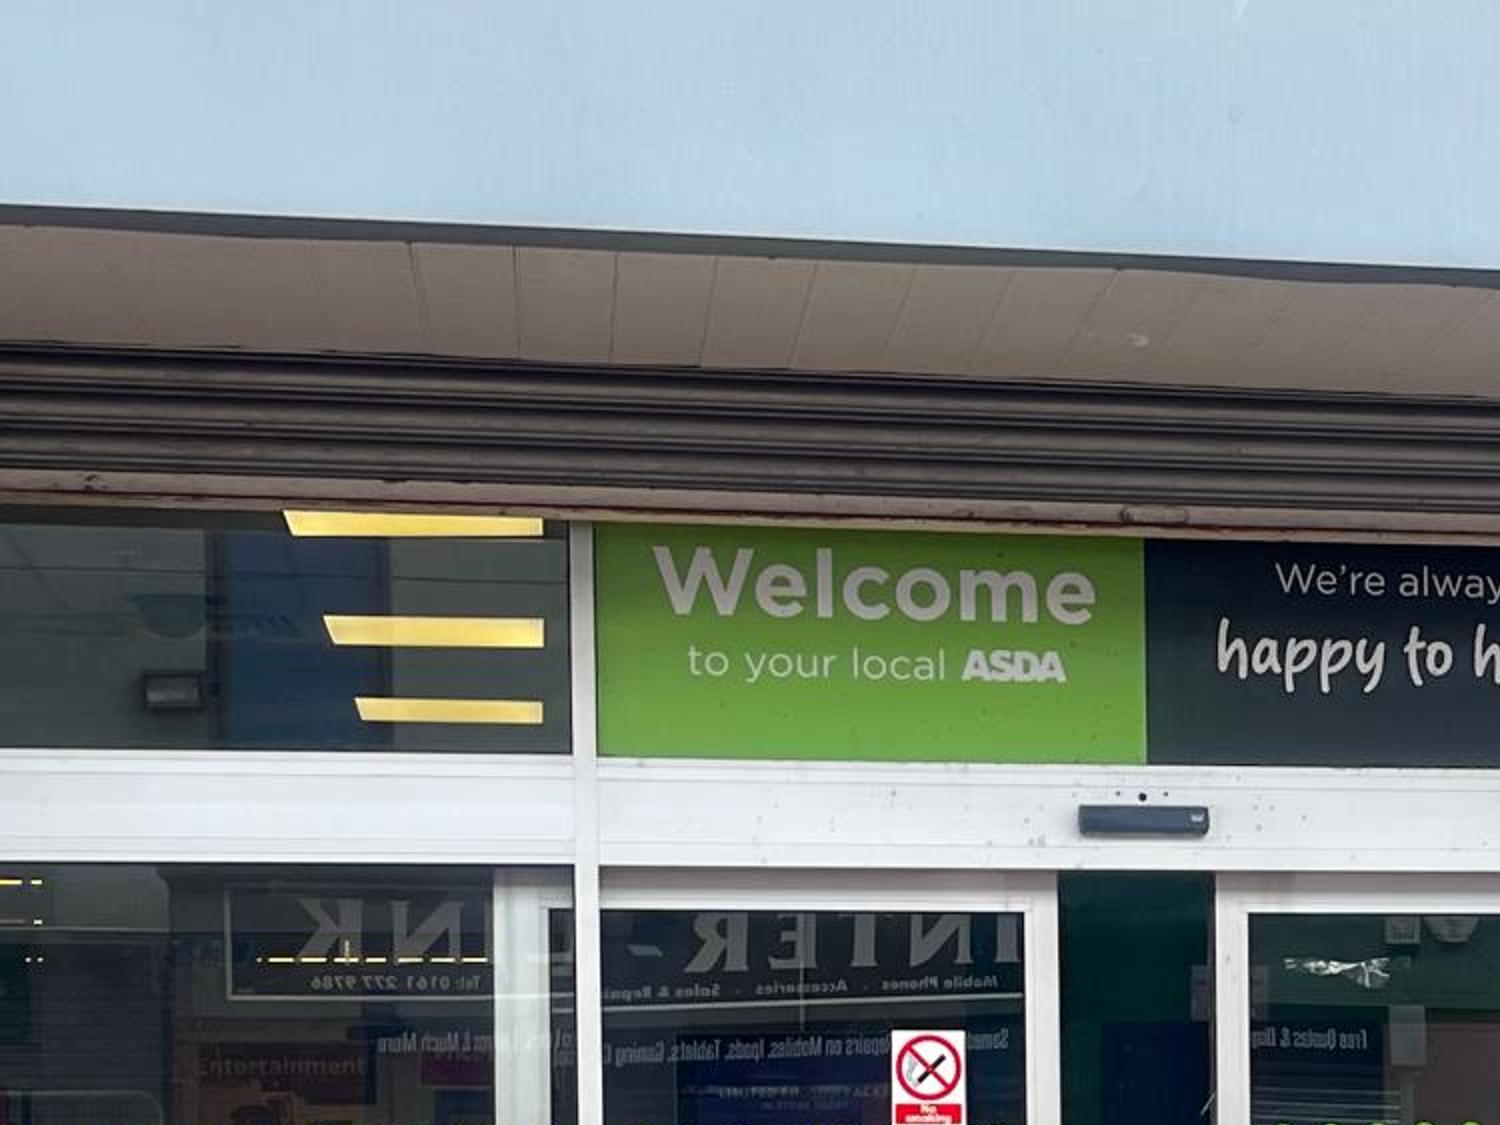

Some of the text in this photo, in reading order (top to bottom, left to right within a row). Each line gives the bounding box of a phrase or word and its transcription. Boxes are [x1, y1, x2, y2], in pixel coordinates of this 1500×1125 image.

[651, 545, 1097, 625] Welcome
[1275, 562, 1387, 599] We're
[687, 645, 1067, 684] to your local ASDA
[1216, 616, 1387, 694] happy
[1402, 624, 1454, 687] to
